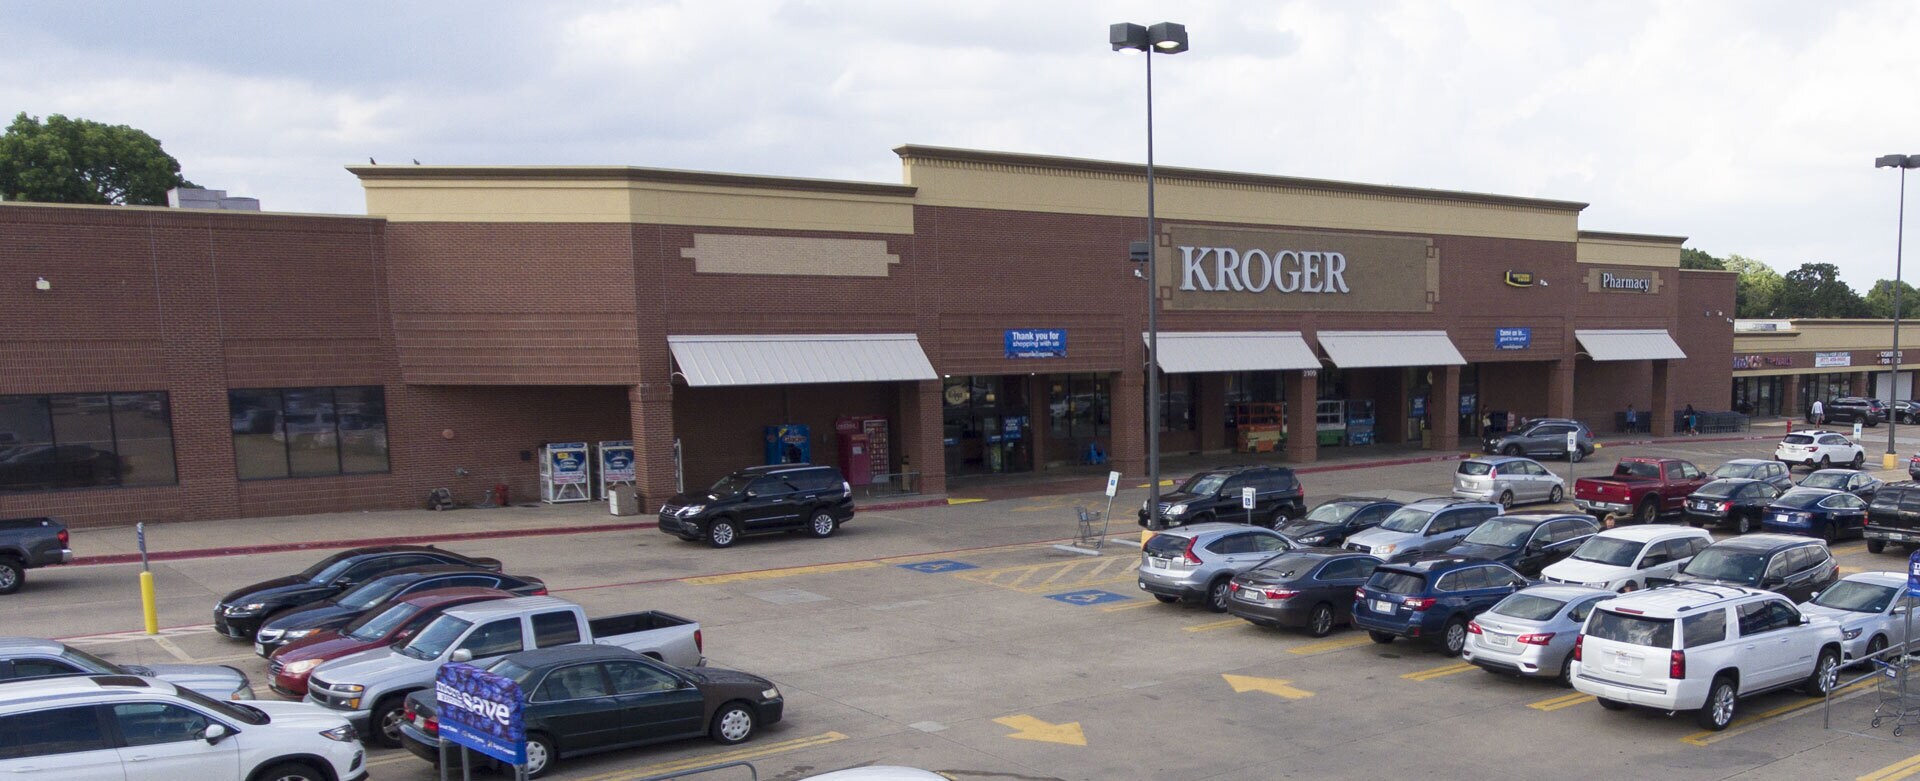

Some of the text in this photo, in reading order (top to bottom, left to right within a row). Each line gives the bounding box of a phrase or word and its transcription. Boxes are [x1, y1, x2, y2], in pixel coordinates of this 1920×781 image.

[1178, 245, 1350, 295] KROGER
[1602, 272, 1650, 292] Pharmacy
[1012, 331, 1060, 342] Thank you for
[1012, 340, 1039, 348] shopping
[462, 692, 510, 726] save
